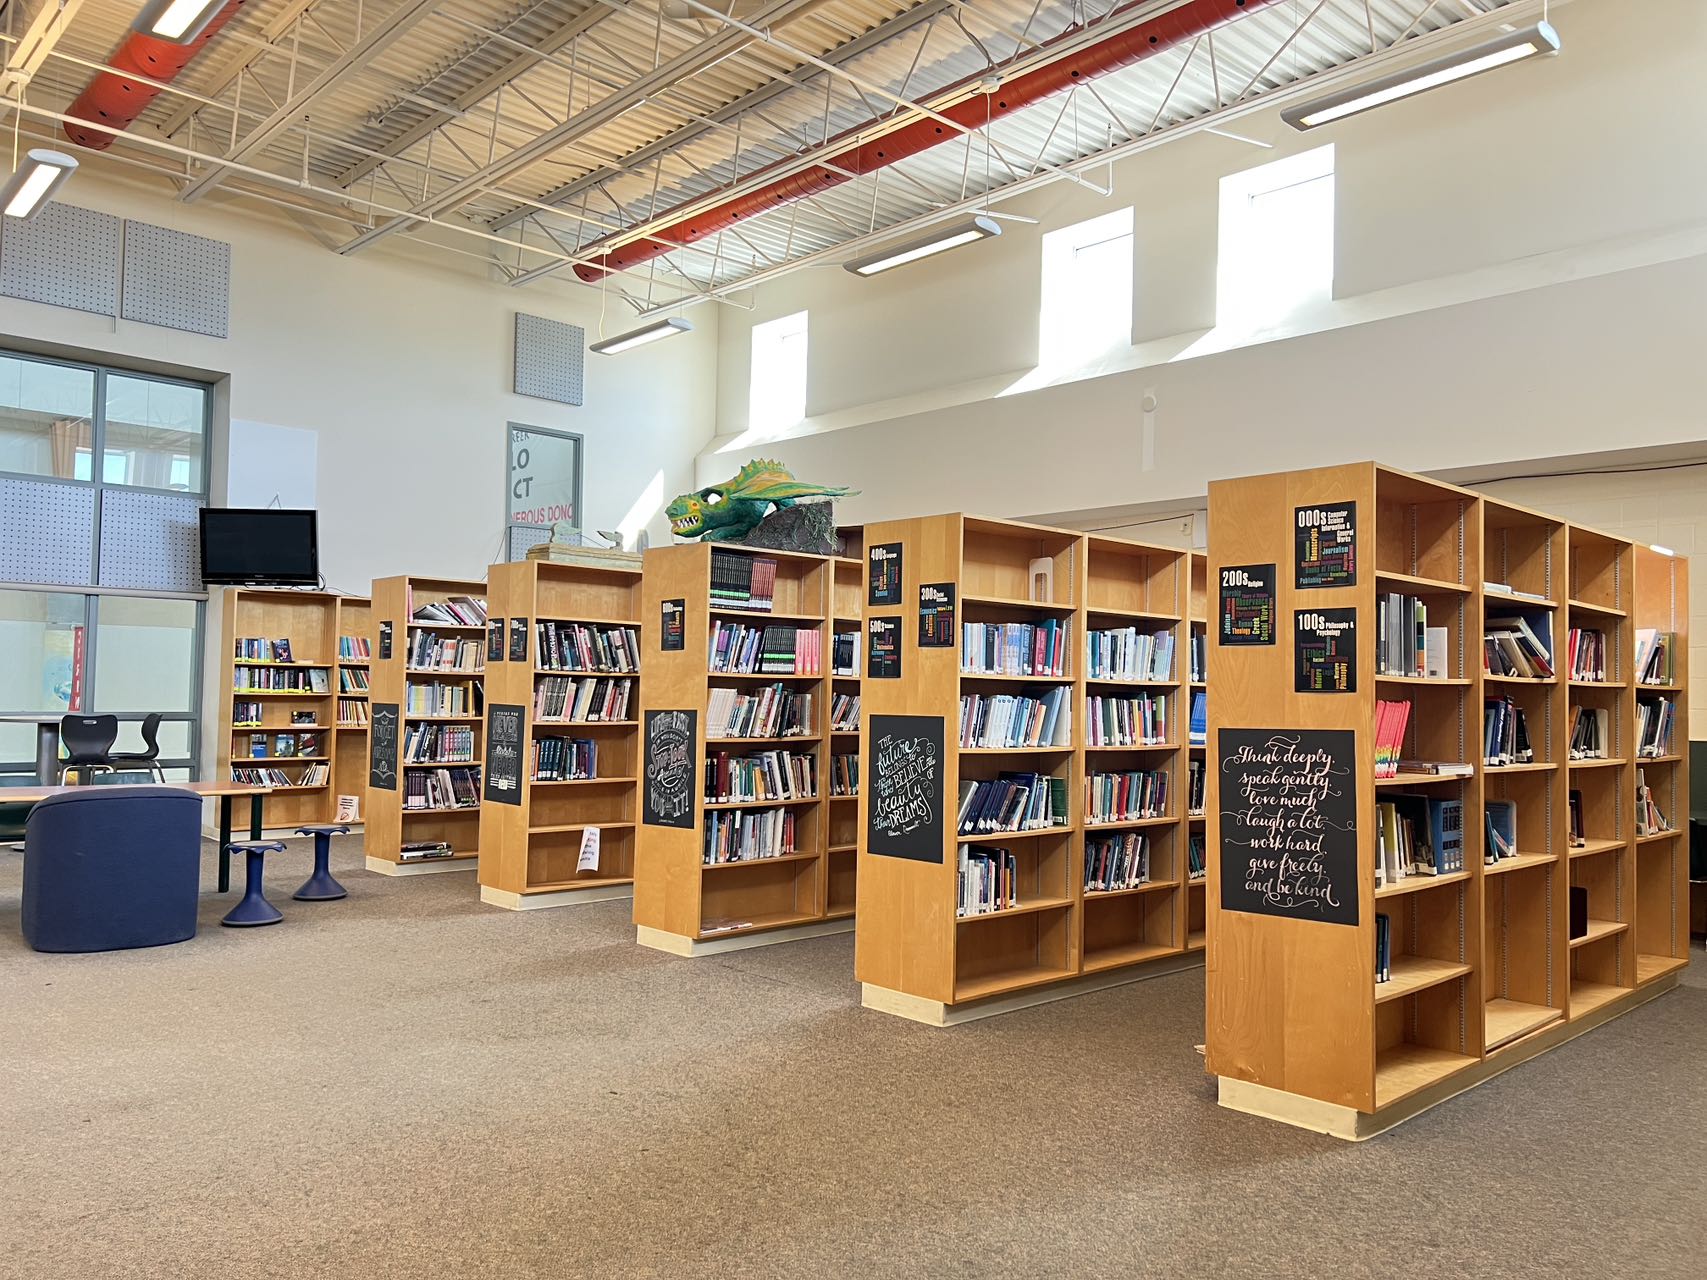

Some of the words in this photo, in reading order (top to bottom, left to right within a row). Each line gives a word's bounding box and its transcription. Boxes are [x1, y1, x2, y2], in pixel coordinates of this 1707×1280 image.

[1222, 570, 1248, 586] 200s
[1298, 613, 1325, 630] 100s
[1316, 629, 1340, 637] Psychology
[878, 734, 893, 749] THE
[892, 755, 928, 789] BELIEVE
[1238, 765, 1284, 797] speak
[888, 796, 927, 829] DREAMS
[1249, 790, 1279, 805] love
[1280, 787, 1318, 813] much
[1287, 818, 1297, 829] a
[1292, 806, 1327, 830] lot.
[1250, 834, 1284, 851] work
[1286, 834, 1328, 855] hard.
[1245, 858, 1279, 880] give
[1279, 852, 1328, 885] freely.
[1277, 879, 1294, 894] be
[1294, 876, 1341, 907] kind
